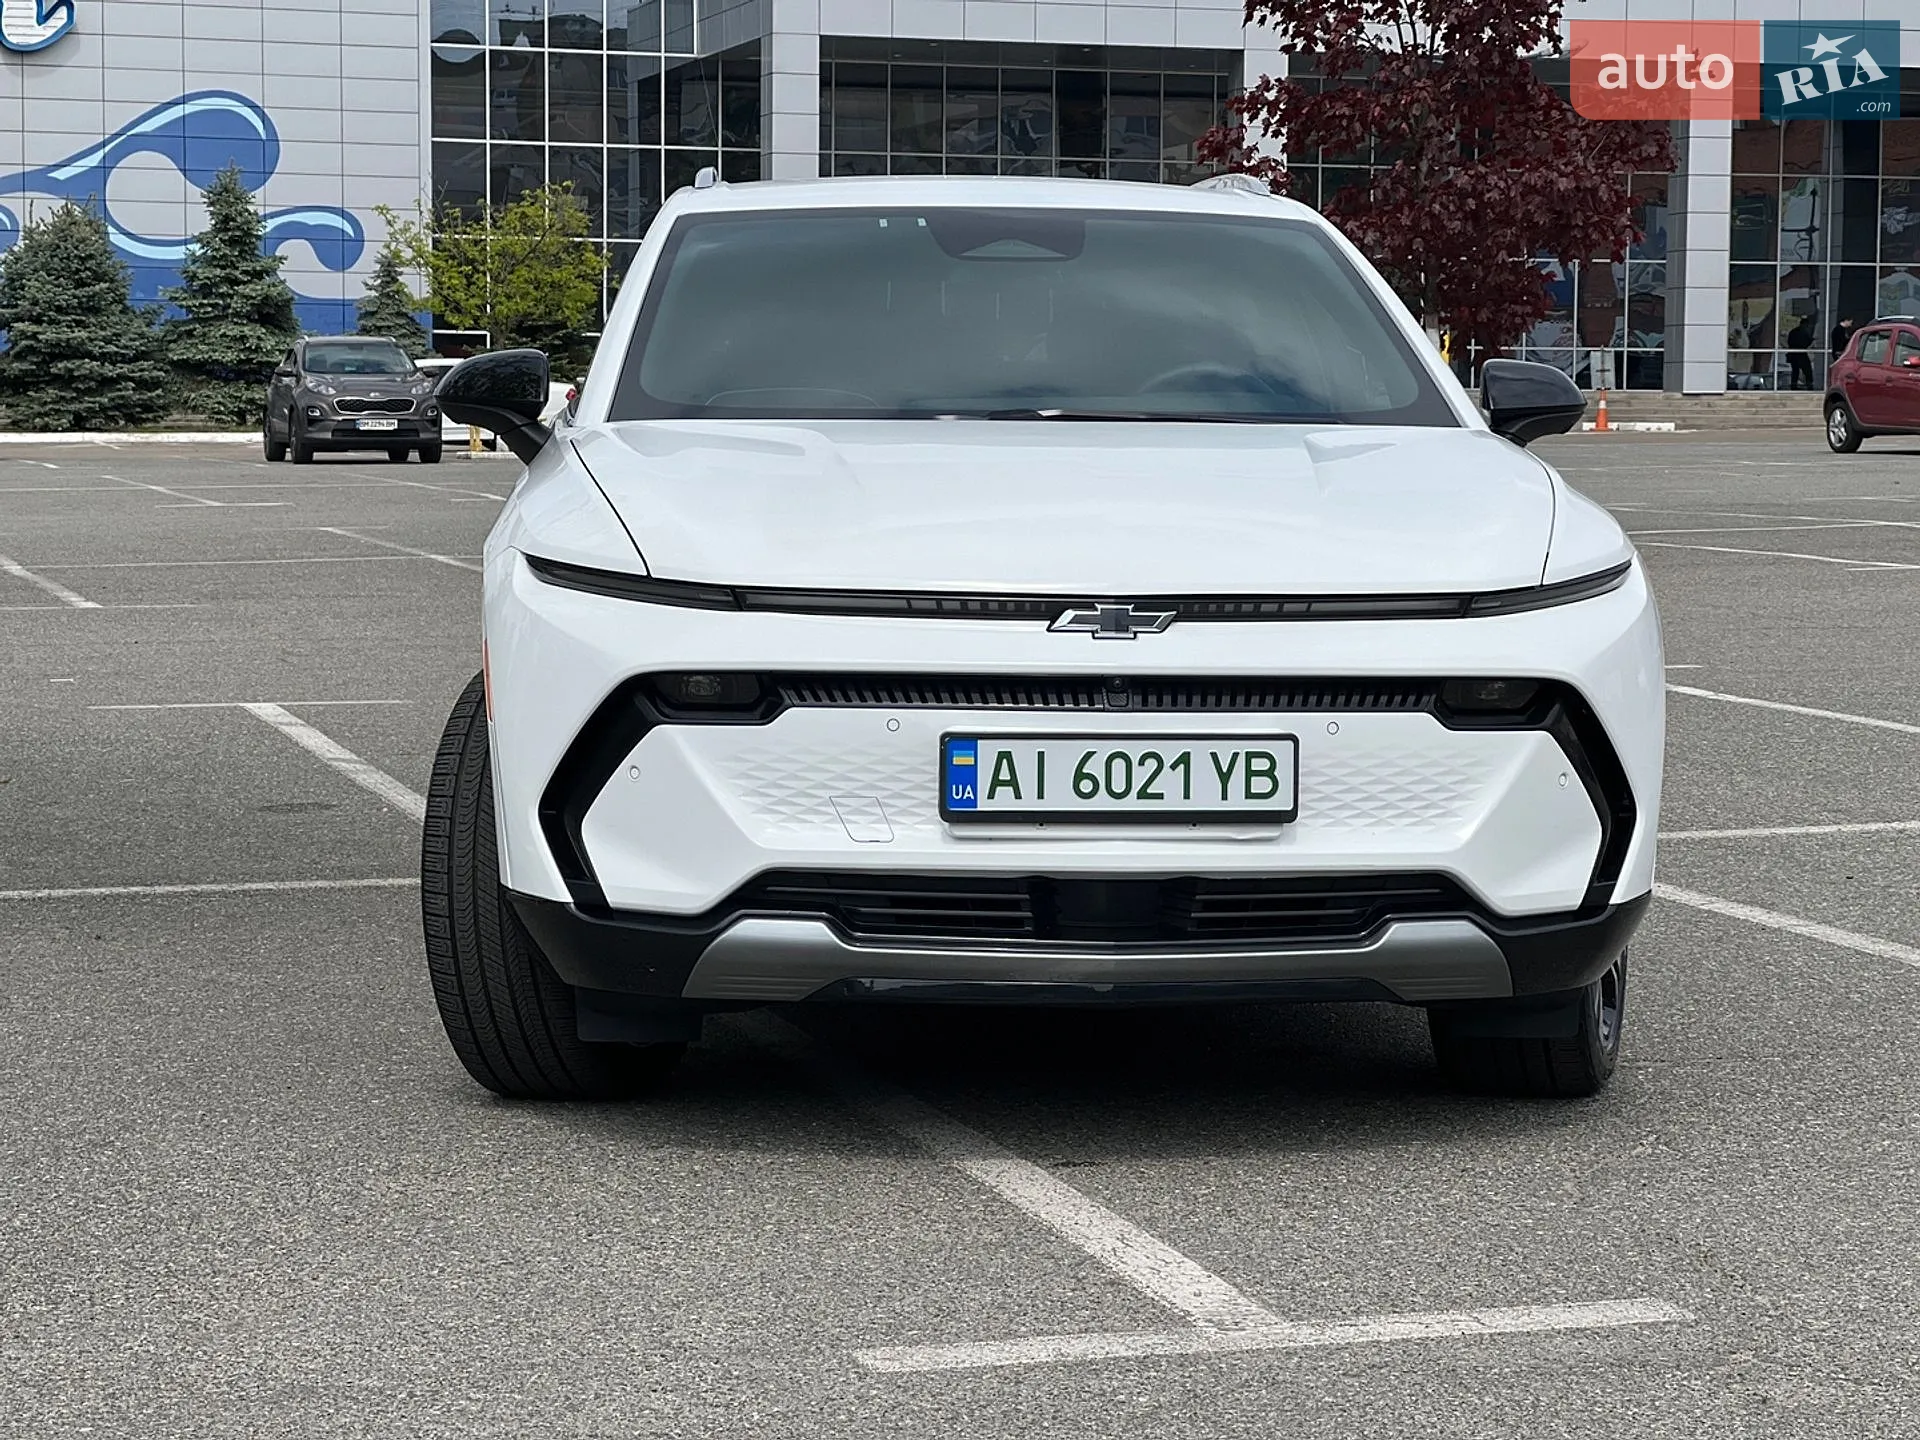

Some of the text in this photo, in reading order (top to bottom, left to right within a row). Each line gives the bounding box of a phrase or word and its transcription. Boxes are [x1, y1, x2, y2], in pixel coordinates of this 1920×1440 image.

[952, 784, 975, 801] UA
[987, 750, 1280, 801] AI 6021 YB
